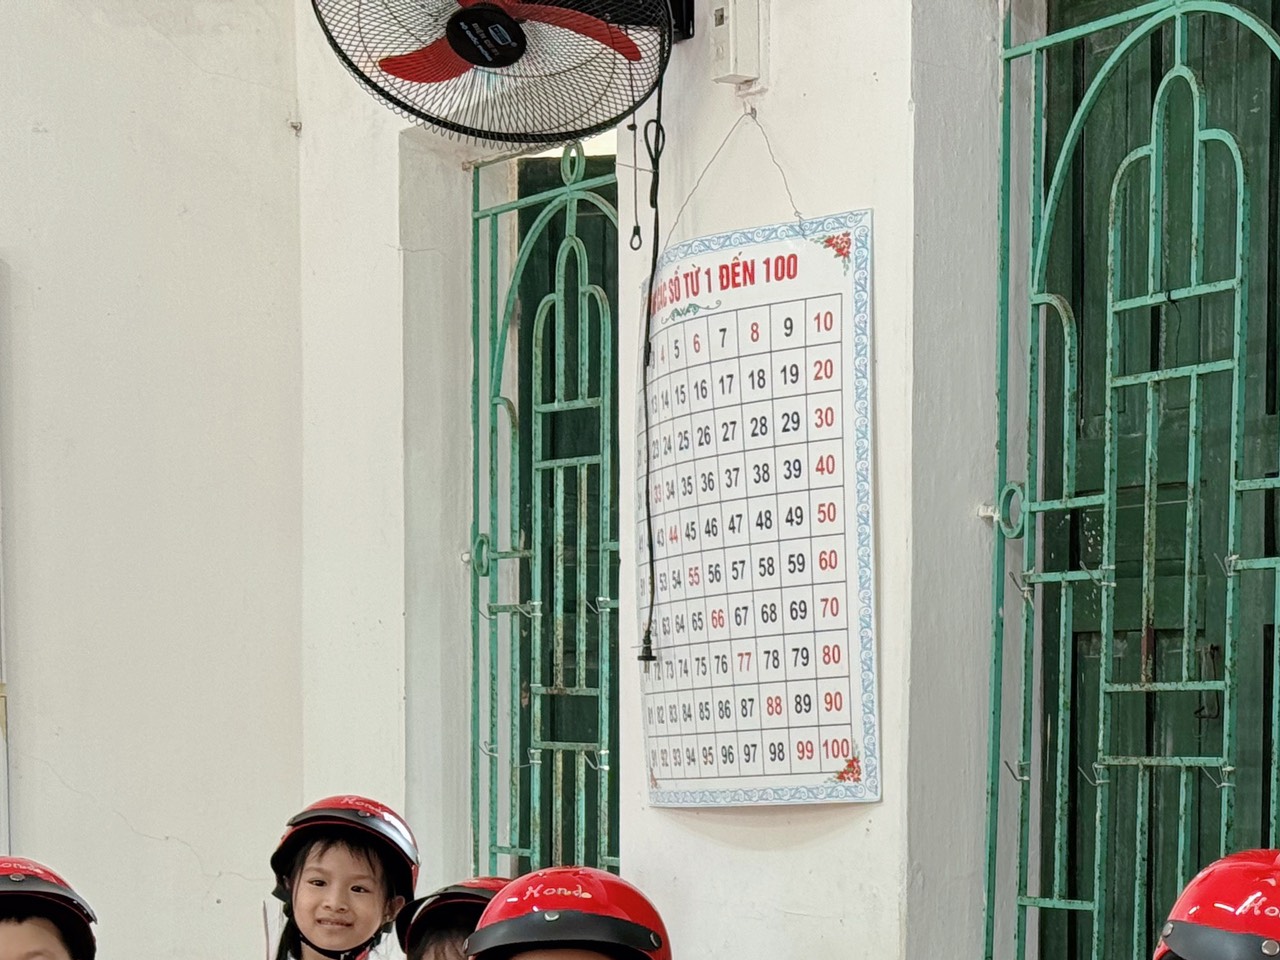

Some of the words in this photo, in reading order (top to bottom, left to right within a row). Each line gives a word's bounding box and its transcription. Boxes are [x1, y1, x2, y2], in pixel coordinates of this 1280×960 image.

[668, 265, 681, 304] SỐ
[683, 263, 701, 299] TỪ
[704, 267, 712, 293] 1
[718, 251, 755, 290] ĐẾN
[763, 253, 798, 284] 100
[674, 340, 680, 359] 5
[693, 333, 701, 353] 6
[719, 328, 727, 348] 7
[750, 322, 760, 342] 8
[784, 317, 794, 337] 9
[814, 311, 833, 332] 10
[661, 389, 669, 410] 14
[675, 384, 686, 405] 15
[694, 379, 708, 400] 16
[719, 374, 734, 395] 17
[748, 369, 766, 390] 18
[780, 364, 799, 385] 19
[813, 359, 834, 381] 20
[663, 435, 672, 455] 24
[678, 430, 689, 451] 25
[697, 425, 711, 446] 26
[722, 421, 737, 442] 27
[750, 416, 768, 437] 28
[781, 411, 800, 432] 29
[814, 407, 834, 428] 30
[666, 480, 675, 500] 34
[681, 476, 693, 496] 35
[701, 472, 715, 492] 36
[725, 467, 740, 488] 37
[753, 463, 770, 484] 38
[783, 458, 801, 480] 39
[815, 454, 835, 475] 40
[669, 525, 678, 544] 44
[685, 521, 696, 541] 45
[705, 517, 718, 537] 46
[728, 513, 743, 534] 47
[755, 509, 773, 530] 48
[785, 506, 804, 527] 49
[817, 502, 836, 523] 50
[659, 572, 667, 592] 53
[672, 569, 681, 590] 54
[688, 566, 700, 587] 55
[708, 563, 721, 584] 56
[731, 560, 746, 581] 57
[758, 556, 775, 577] 58
[787, 552, 806, 574] 59
[818, 549, 838, 570] 60
[662, 616, 670, 636] 63
[675, 613, 685, 634] 64
[691, 611, 704, 632] 65
[711, 608, 725, 629] 66
[734, 606, 749, 627] 67
[761, 602, 777, 624] 68
[789, 599, 808, 621] 69
[820, 596, 840, 618] 70
[665, 660, 674, 679] 73
[678, 658, 688, 678] 74
[695, 656, 707, 676] 75
[714, 654, 728, 674] 76
[737, 651, 752, 672] 77
[763, 649, 780, 670] 78
[792, 646, 810, 668] 79
[822, 644, 841, 665] 80
[657, 705, 665, 724] 82
[669, 704, 678, 723] 83
[682, 703, 692, 722] 84
[699, 701, 711, 721] 85
[718, 699, 731, 720] 86
[740, 698, 755, 718] 87
[766, 695, 783, 716] 88
[794, 694, 812, 714] 89
[824, 691, 843, 713] 90
[661, 748, 669, 767] 92
[673, 747, 681, 767] 93
[686, 747, 696, 766] 94
[702, 746, 714, 766] 95
[721, 744, 735, 765] 96
[743, 743, 757, 763] 97
[769, 741, 785, 762] 98
[796, 740, 814, 760] 99
[822, 737, 850, 759] 100
